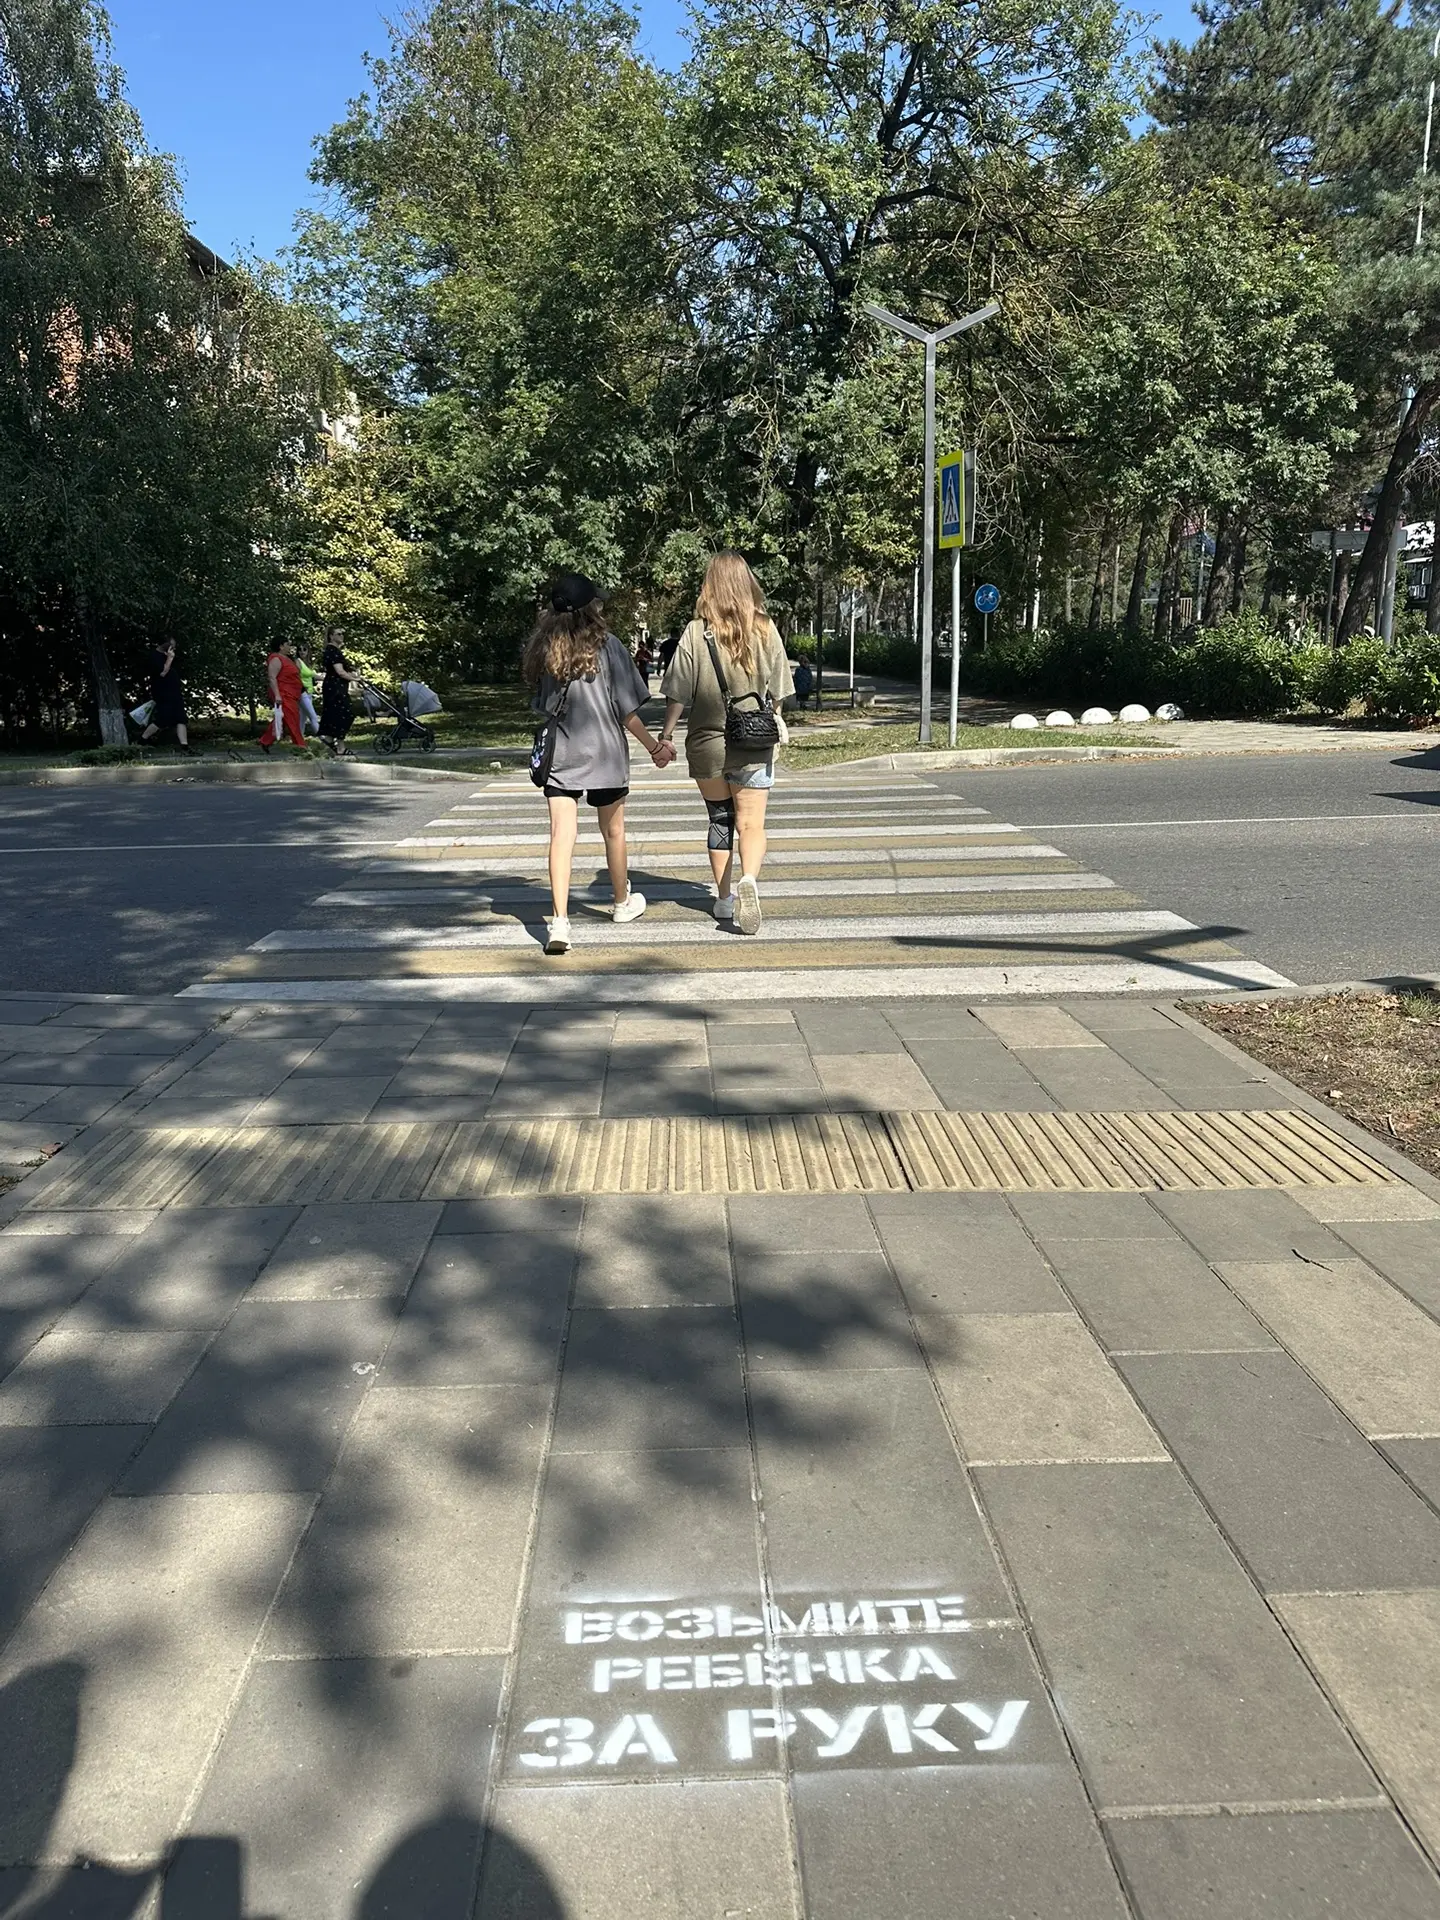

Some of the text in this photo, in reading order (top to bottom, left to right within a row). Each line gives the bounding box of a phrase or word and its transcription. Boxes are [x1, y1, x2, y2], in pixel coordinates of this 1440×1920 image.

[564, 1596, 966, 1644] ВОЗЬМИТЕ
[519, 1700, 1030, 1767] ЗА РУКУ
